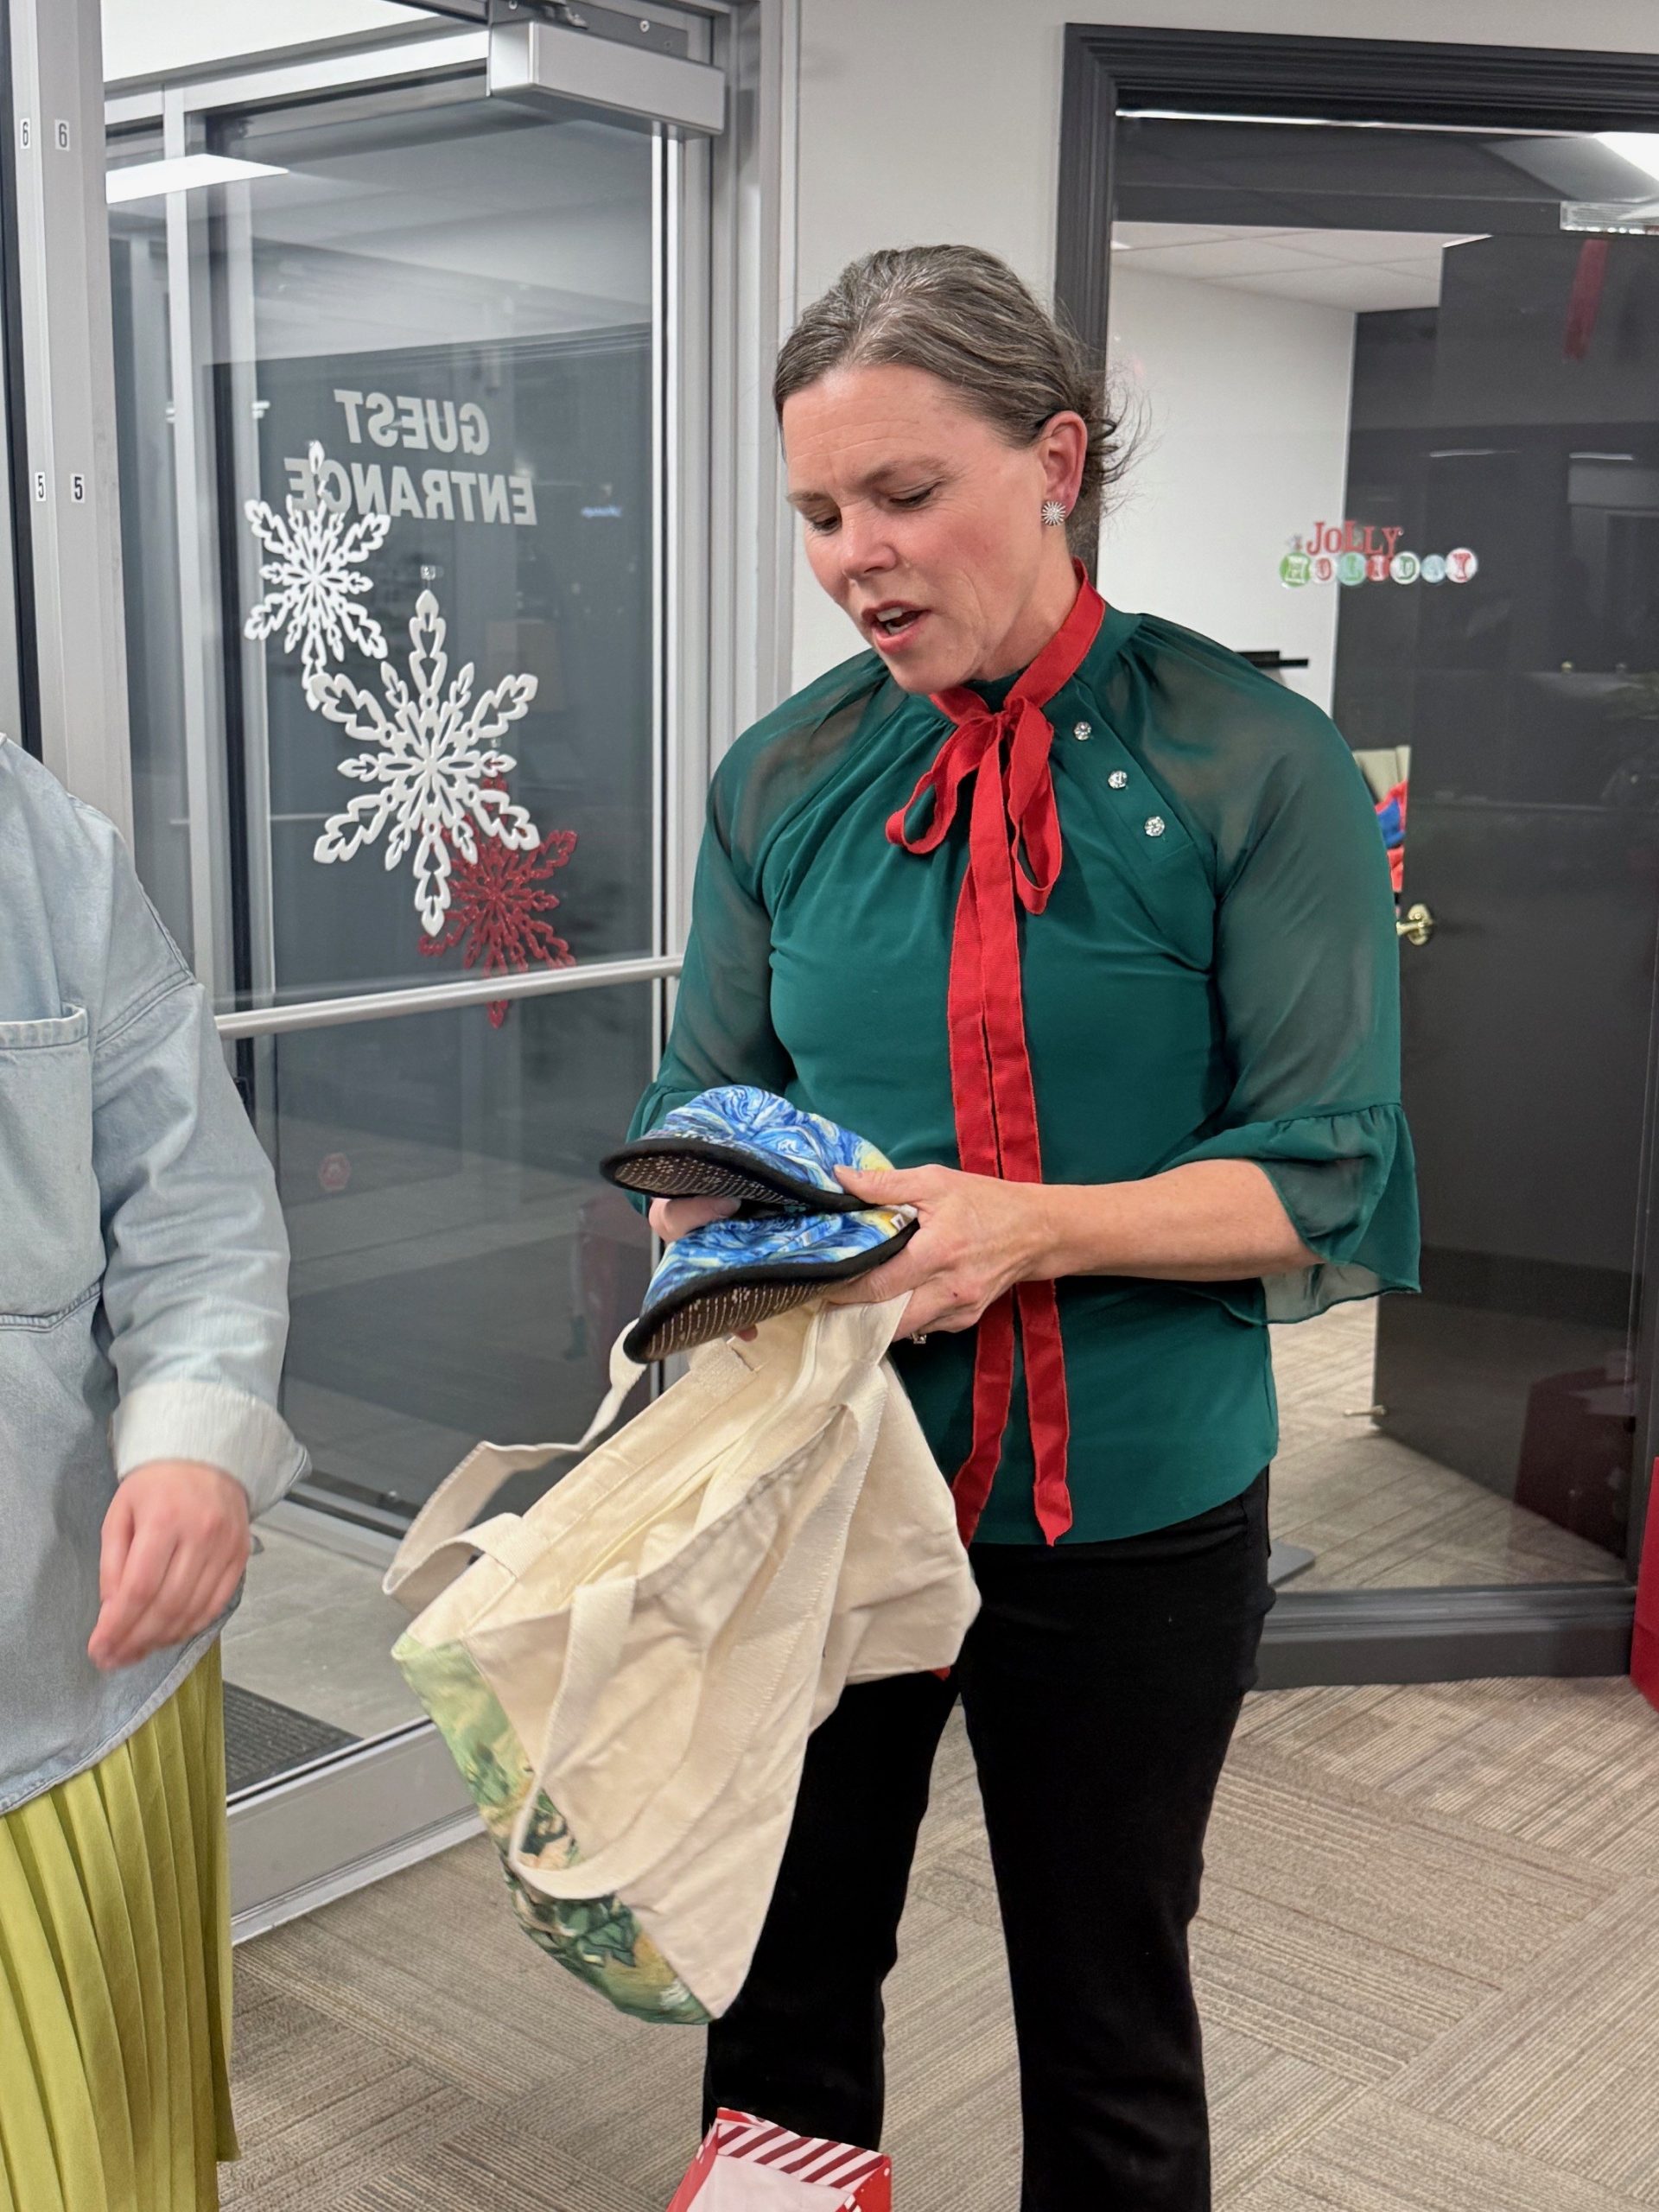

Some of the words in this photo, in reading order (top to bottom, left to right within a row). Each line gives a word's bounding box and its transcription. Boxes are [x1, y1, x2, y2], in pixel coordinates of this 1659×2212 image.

[22, 121, 29, 147] 6
[58, 122, 68, 149] 6
[37, 474, 45, 499] 5
[73, 475, 83, 500] 5
[1306, 520, 1403, 560] JOLLY
